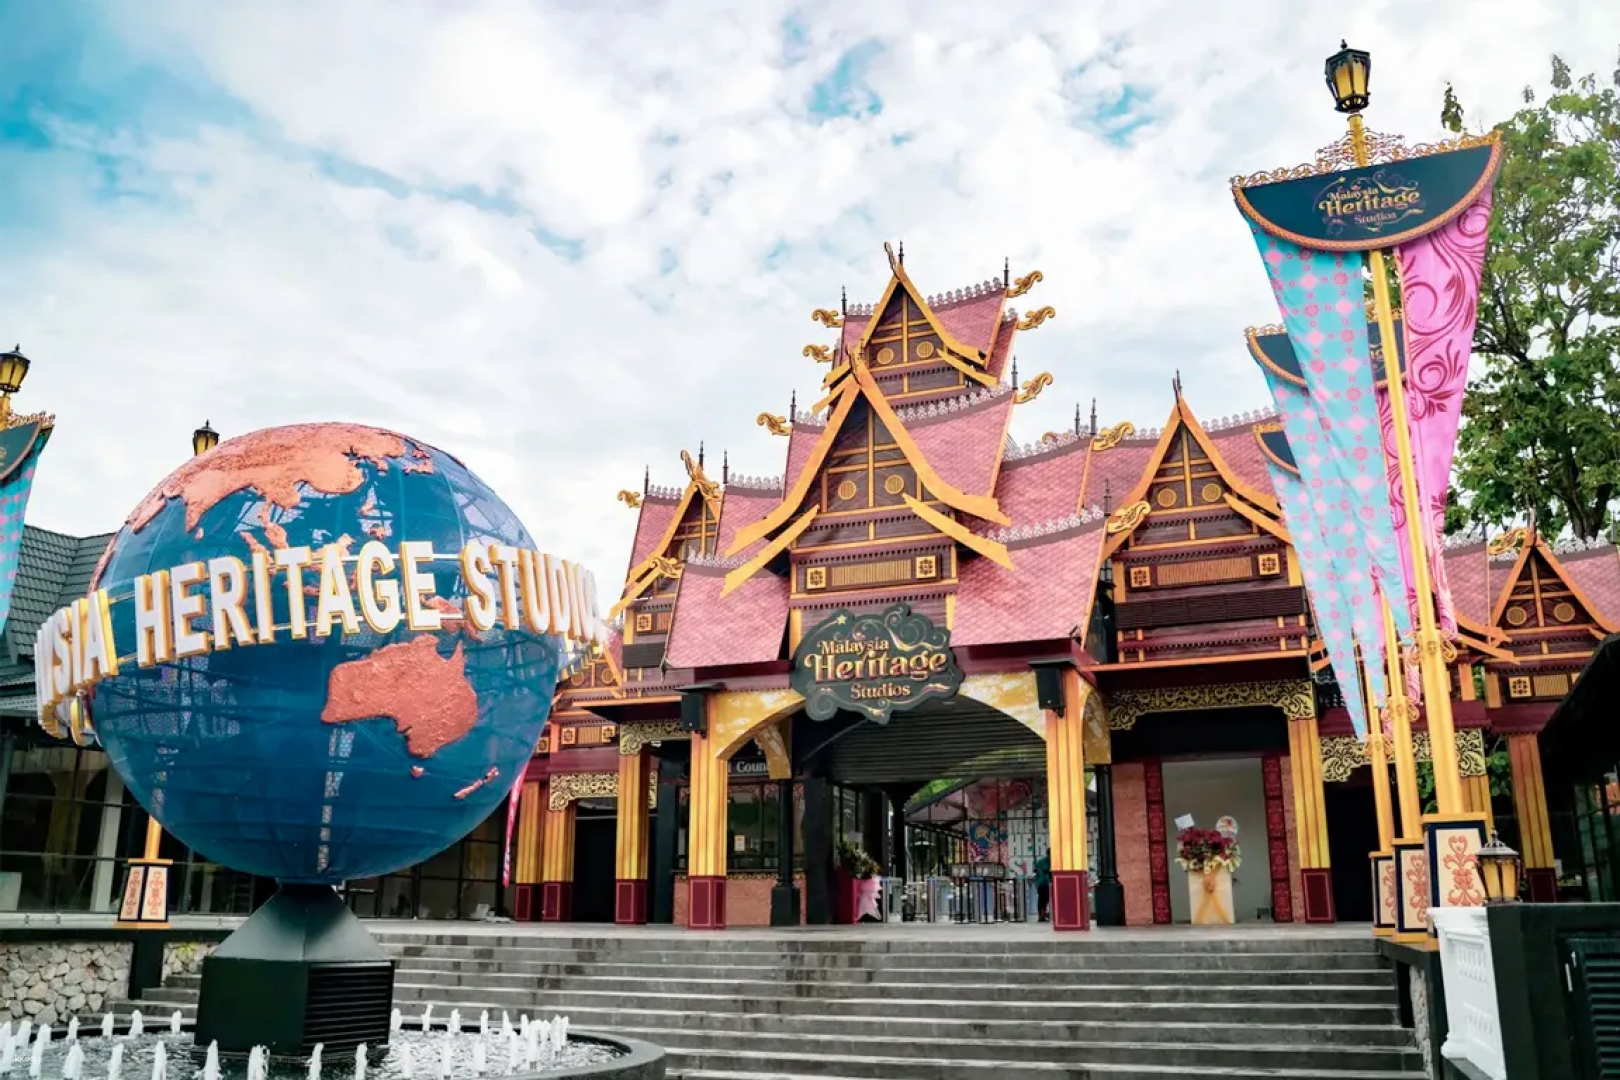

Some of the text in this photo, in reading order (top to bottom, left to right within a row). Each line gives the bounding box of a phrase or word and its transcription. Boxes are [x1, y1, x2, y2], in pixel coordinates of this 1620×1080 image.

[1319, 191, 1420, 217] Heritage
[1326, 187, 1378, 202] Malaysia
[1354, 211, 1397, 224] Studios
[135, 540, 442, 667] HERITAGE
[817, 636, 890, 656] Malaysia
[804, 650, 948, 684] Heritage
[850, 682, 912, 700] Studios
[736, 760, 768, 773] Coun
